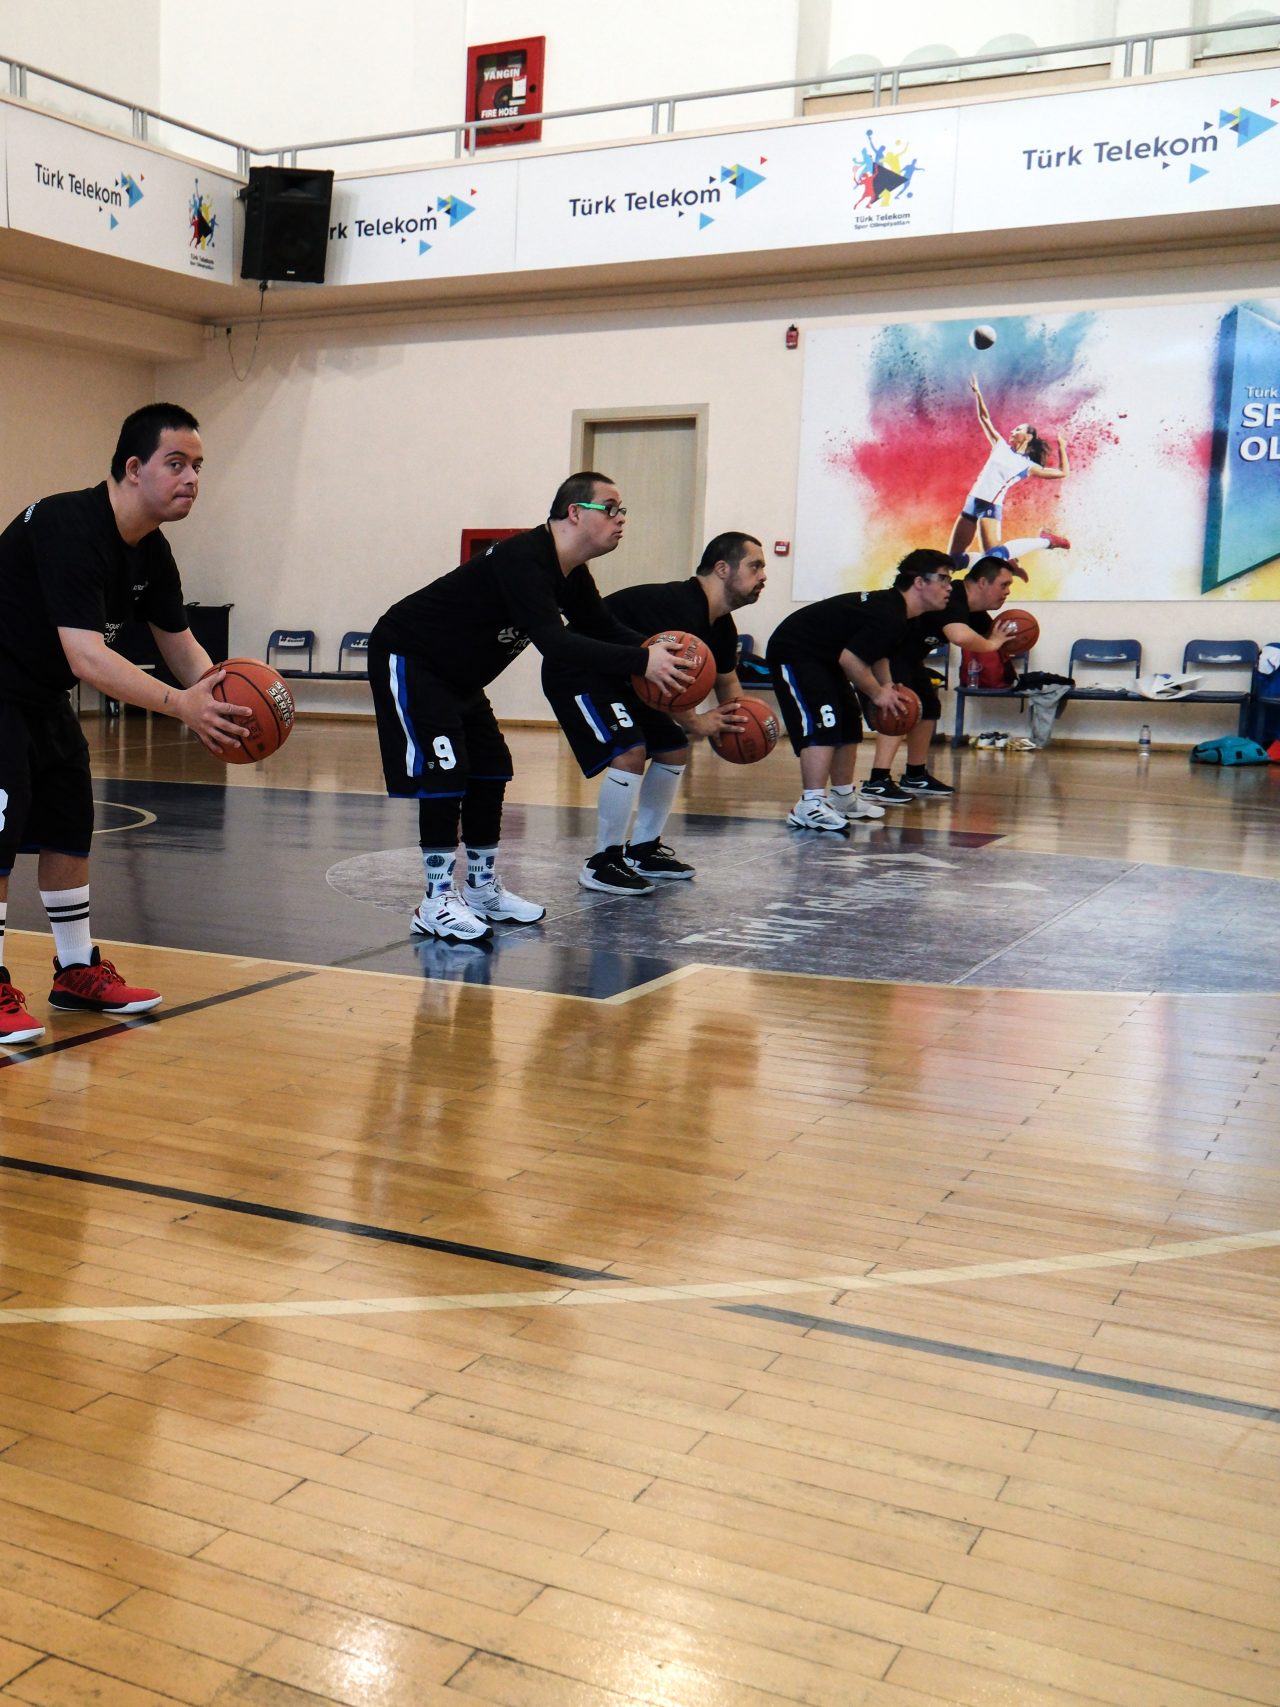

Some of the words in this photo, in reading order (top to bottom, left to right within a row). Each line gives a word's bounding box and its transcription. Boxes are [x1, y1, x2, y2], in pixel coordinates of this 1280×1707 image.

[483, 68, 521, 82] YANGIN
[481, 109, 497, 119] FIRE
[498, 106, 519, 117] HOSE
[1023, 146, 1084, 170] Türk
[1094, 135, 1218, 163] Telekom
[35, 163, 64, 190] Türk
[68, 173, 122, 207] Telekom
[569, 195, 617, 217] Türk
[624, 188, 721, 211] Telekom
[329, 222, 348, 240] rk
[355, 216, 438, 238] Telekom
[610, 702, 634, 728] 5
[820, 704, 836, 728] 6
[432, 735, 457, 770] 9
